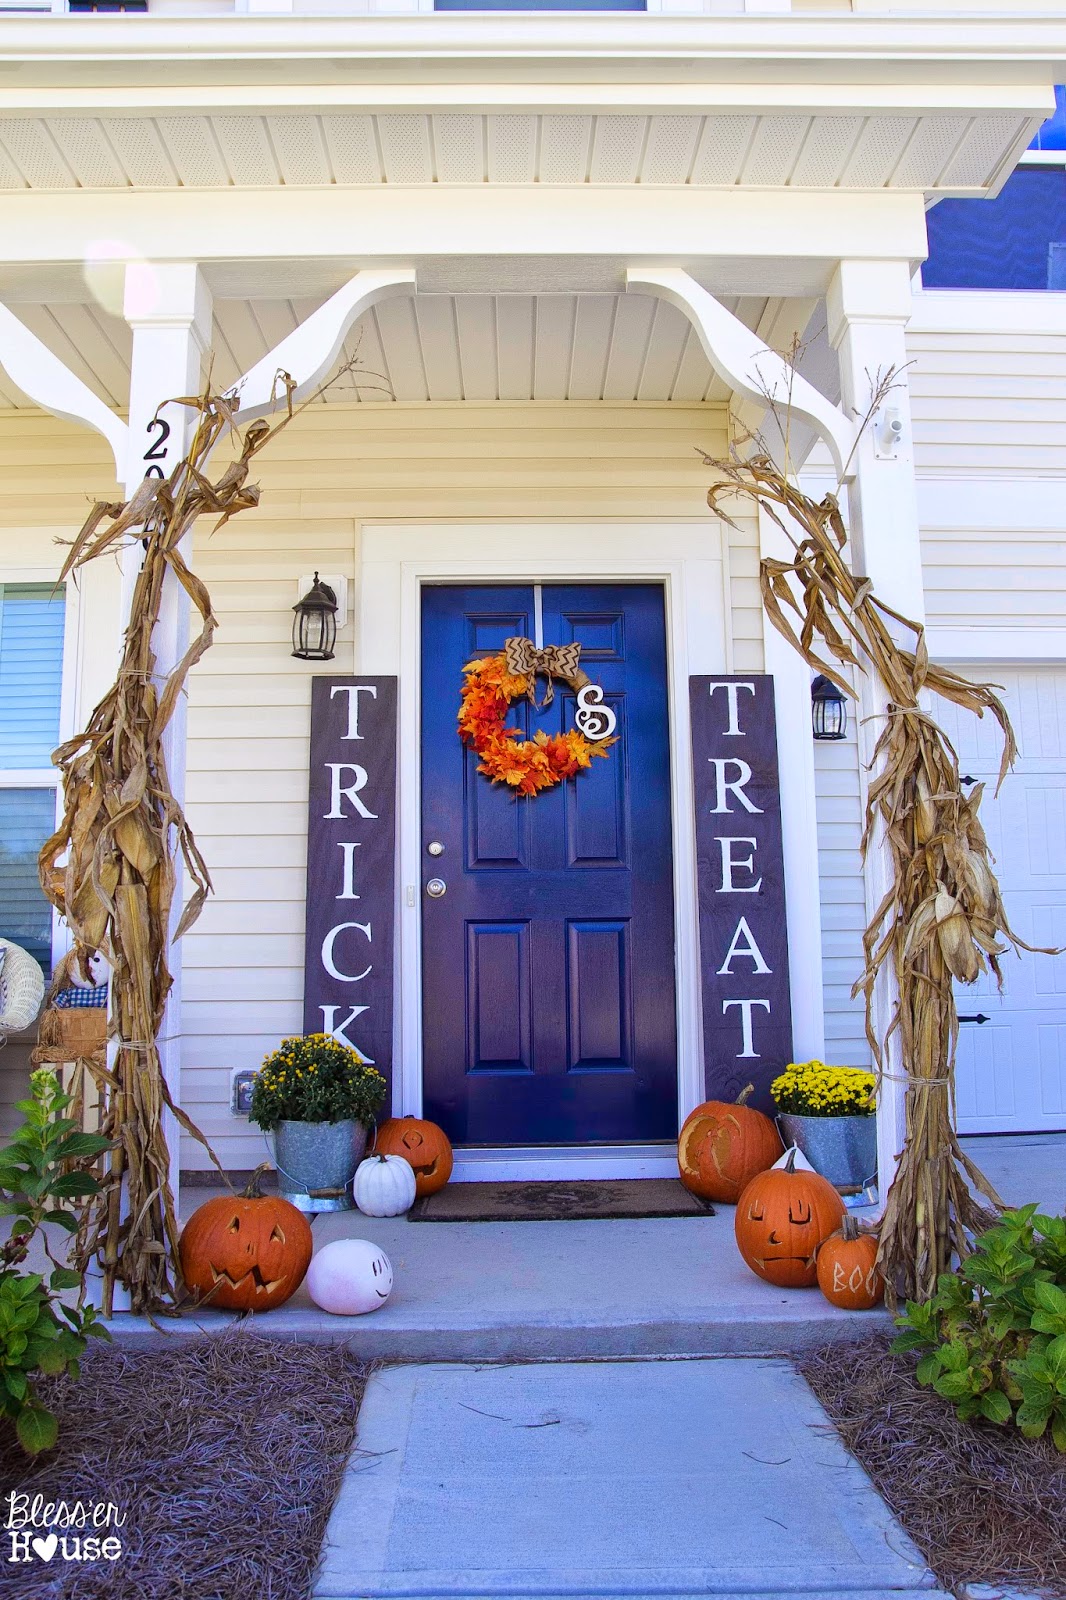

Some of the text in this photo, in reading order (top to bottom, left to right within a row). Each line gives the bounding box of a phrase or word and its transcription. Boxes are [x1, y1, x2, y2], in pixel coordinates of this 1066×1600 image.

[575, 684, 617, 740] S
[318, 684, 379, 1065] TRICK
[707, 681, 773, 1059] TREAT
[833, 1261, 879, 1297] BOO
